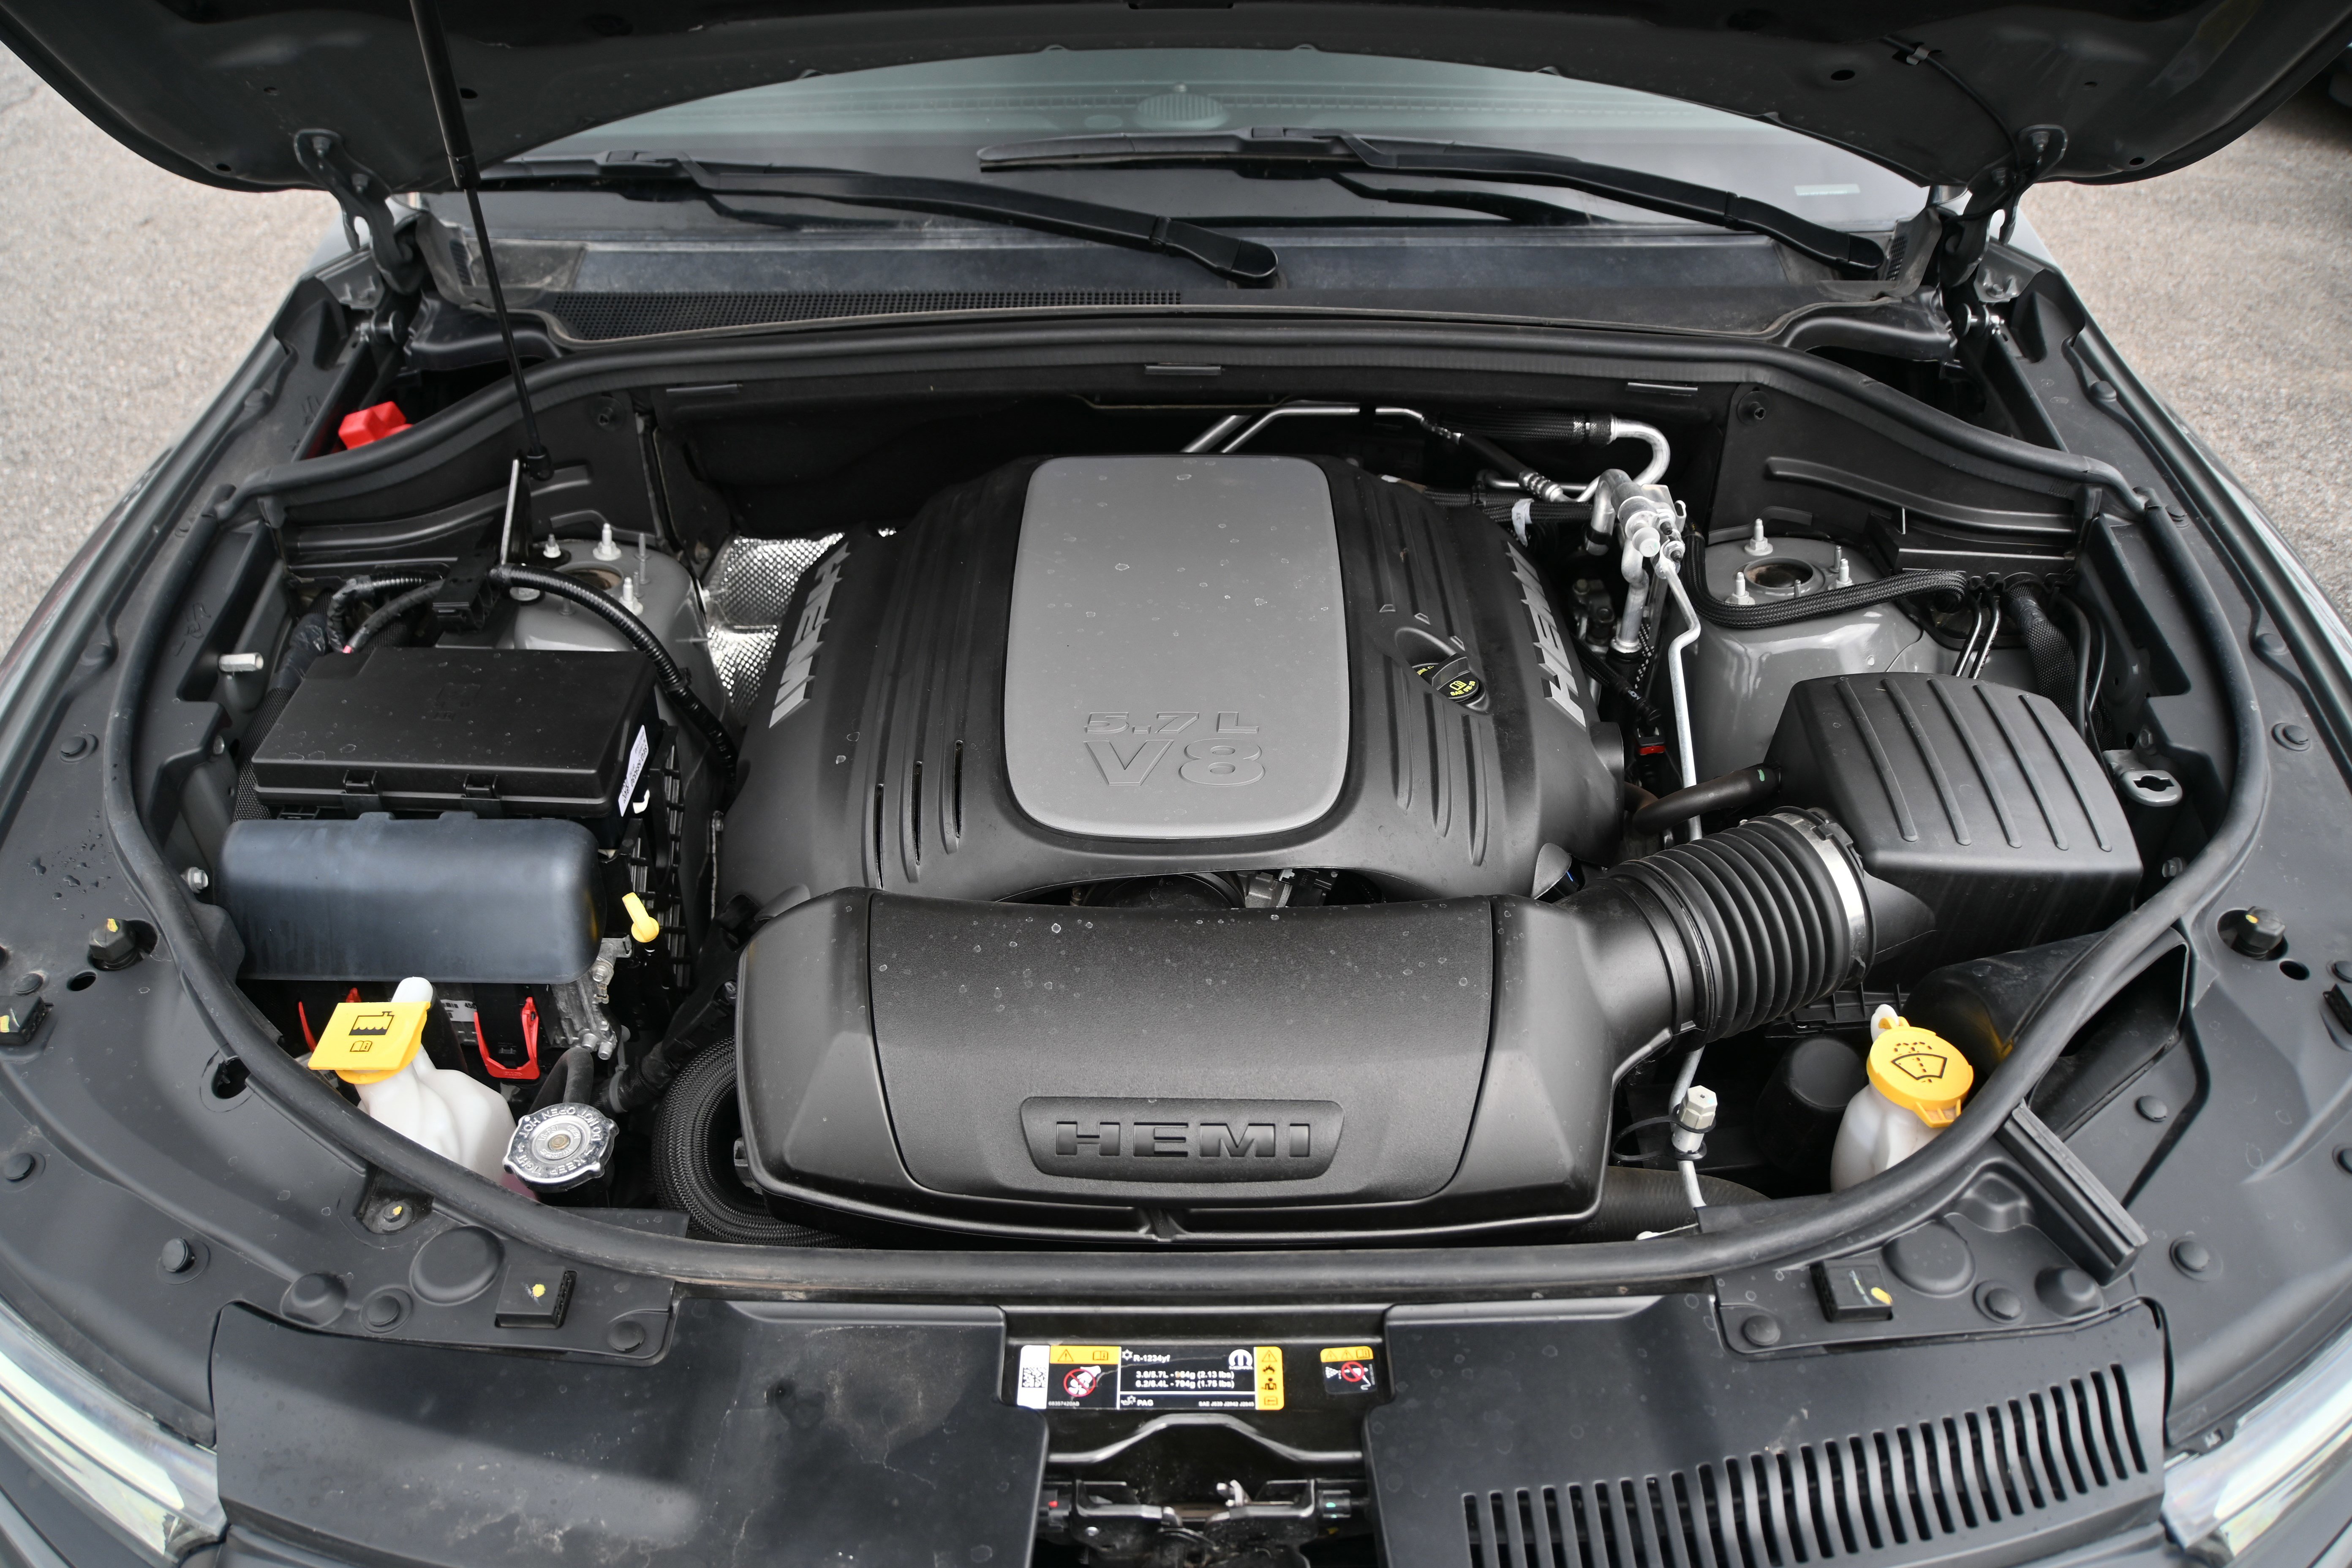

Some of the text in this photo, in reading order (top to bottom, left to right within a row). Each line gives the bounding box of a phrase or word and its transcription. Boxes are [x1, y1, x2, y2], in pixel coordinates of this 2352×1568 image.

[769, 542, 851, 728] HEMI
[1505, 541, 1587, 730] HEMI
[1083, 738, 1266, 787] V8
[542, 1106, 576, 1120] OPEN
[577, 1110, 601, 1127] NOT
[519, 1116, 541, 1138] HOT
[1056, 1121, 1310, 1158] HEMI
[516, 1154, 587, 1176] KEEP TIGHT
[1133, 1354, 1171, 1364] R-1234yf
[1219, 1371, 1235, 1380] lbs)
[1219, 1380, 1235, 1389] lbs)
